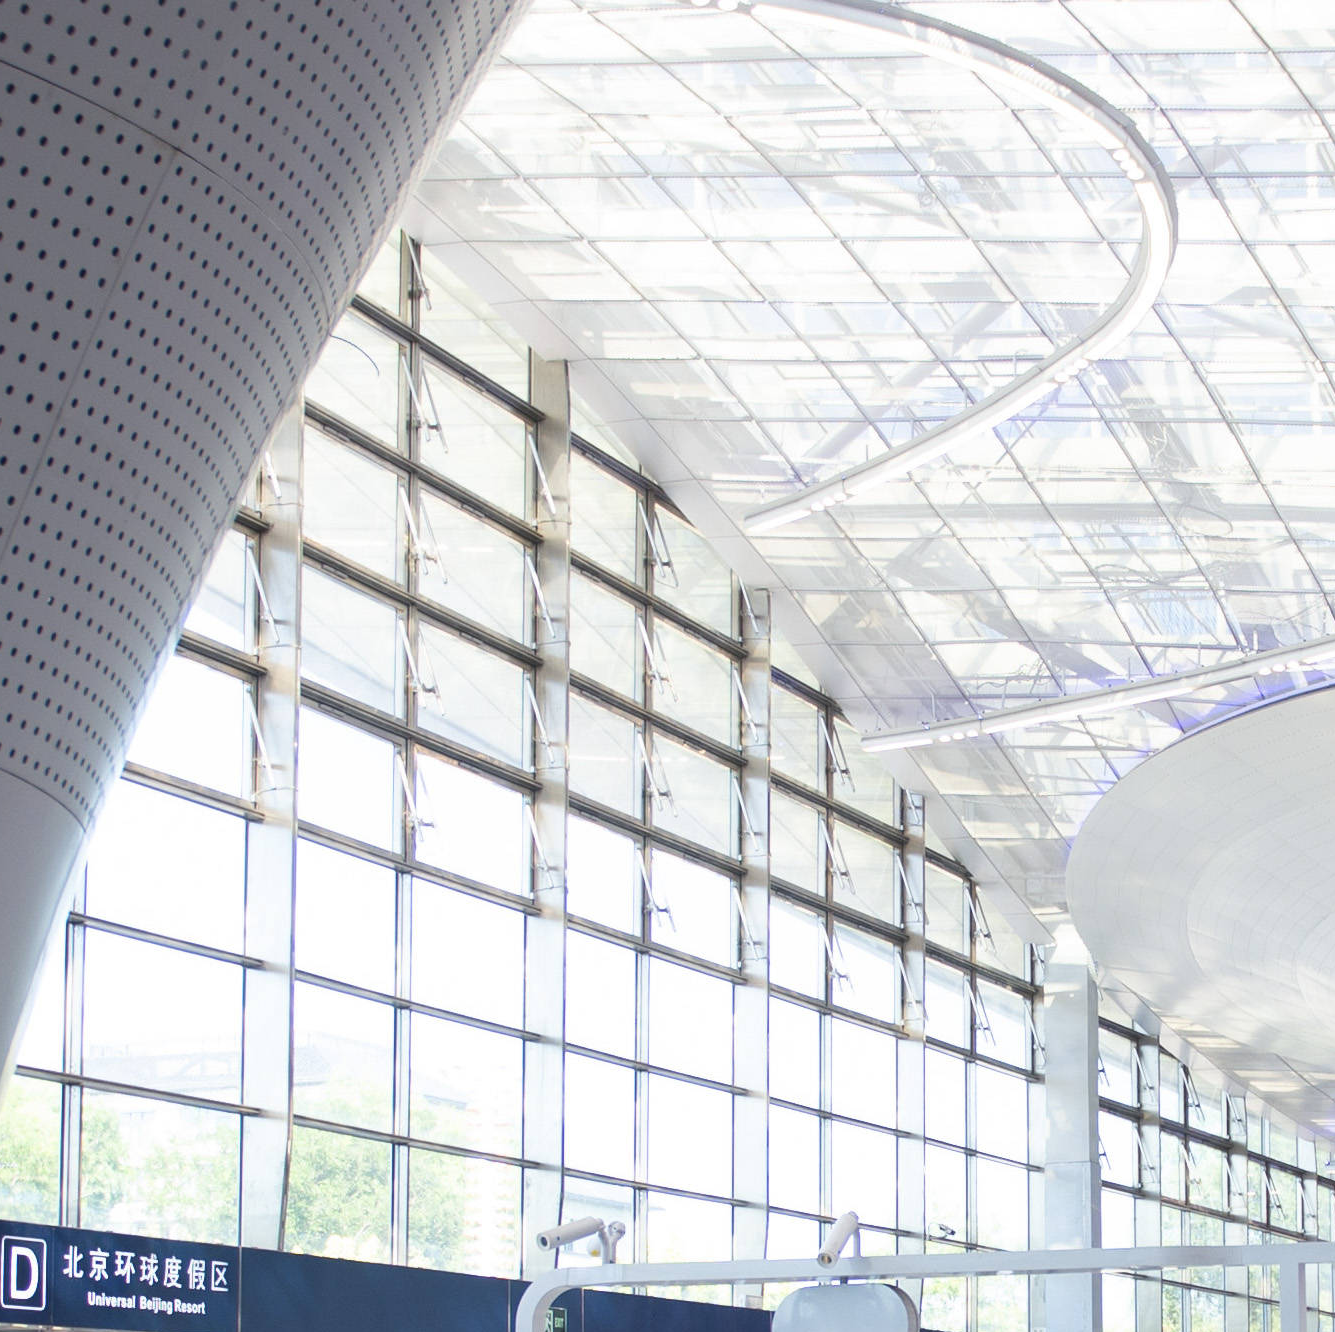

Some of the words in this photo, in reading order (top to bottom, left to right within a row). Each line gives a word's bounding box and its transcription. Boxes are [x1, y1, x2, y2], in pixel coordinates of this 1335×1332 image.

[10, 1245, 39, 1300] D
[63, 1245, 229, 1292] 北京环球度假区
[87, 1291, 136, 1309] Universal
[139, 1295, 172, 1315] Beijing
[174, 1298, 206, 1315] Resort
